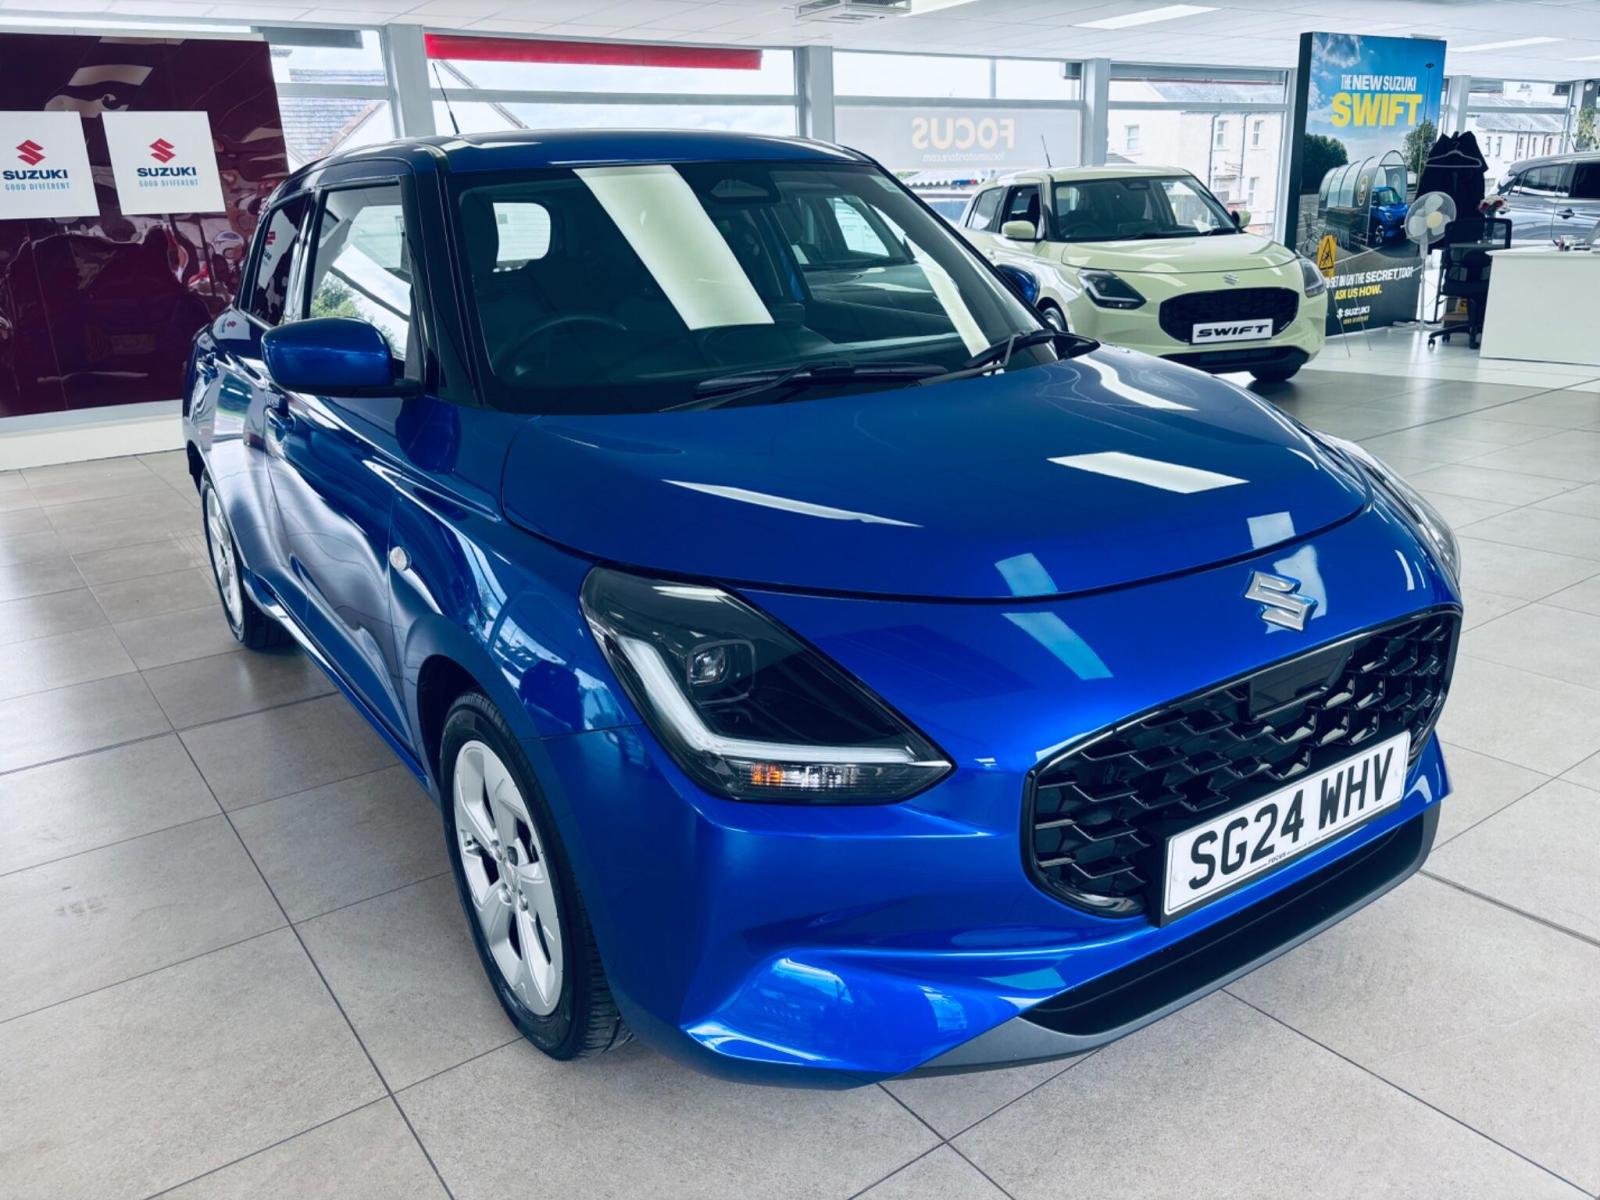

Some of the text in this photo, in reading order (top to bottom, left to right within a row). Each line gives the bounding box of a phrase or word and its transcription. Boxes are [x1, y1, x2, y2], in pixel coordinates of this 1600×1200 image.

[1341, 75, 1417, 92] THE NEW SUZUKI
[1331, 92, 1423, 128] SWIFT
[3, 169, 68, 180] SUZUKI
[137, 167, 197, 177] SUZUKI
[5, 182, 70, 191] GOOD DIFFERENT
[139, 178, 199, 188] GOOD DIFFERENT
[1347, 287, 1359, 299] US
[1196, 324, 1270, 338] SWIFT
[1188, 747, 1394, 890] SG24 WHV
